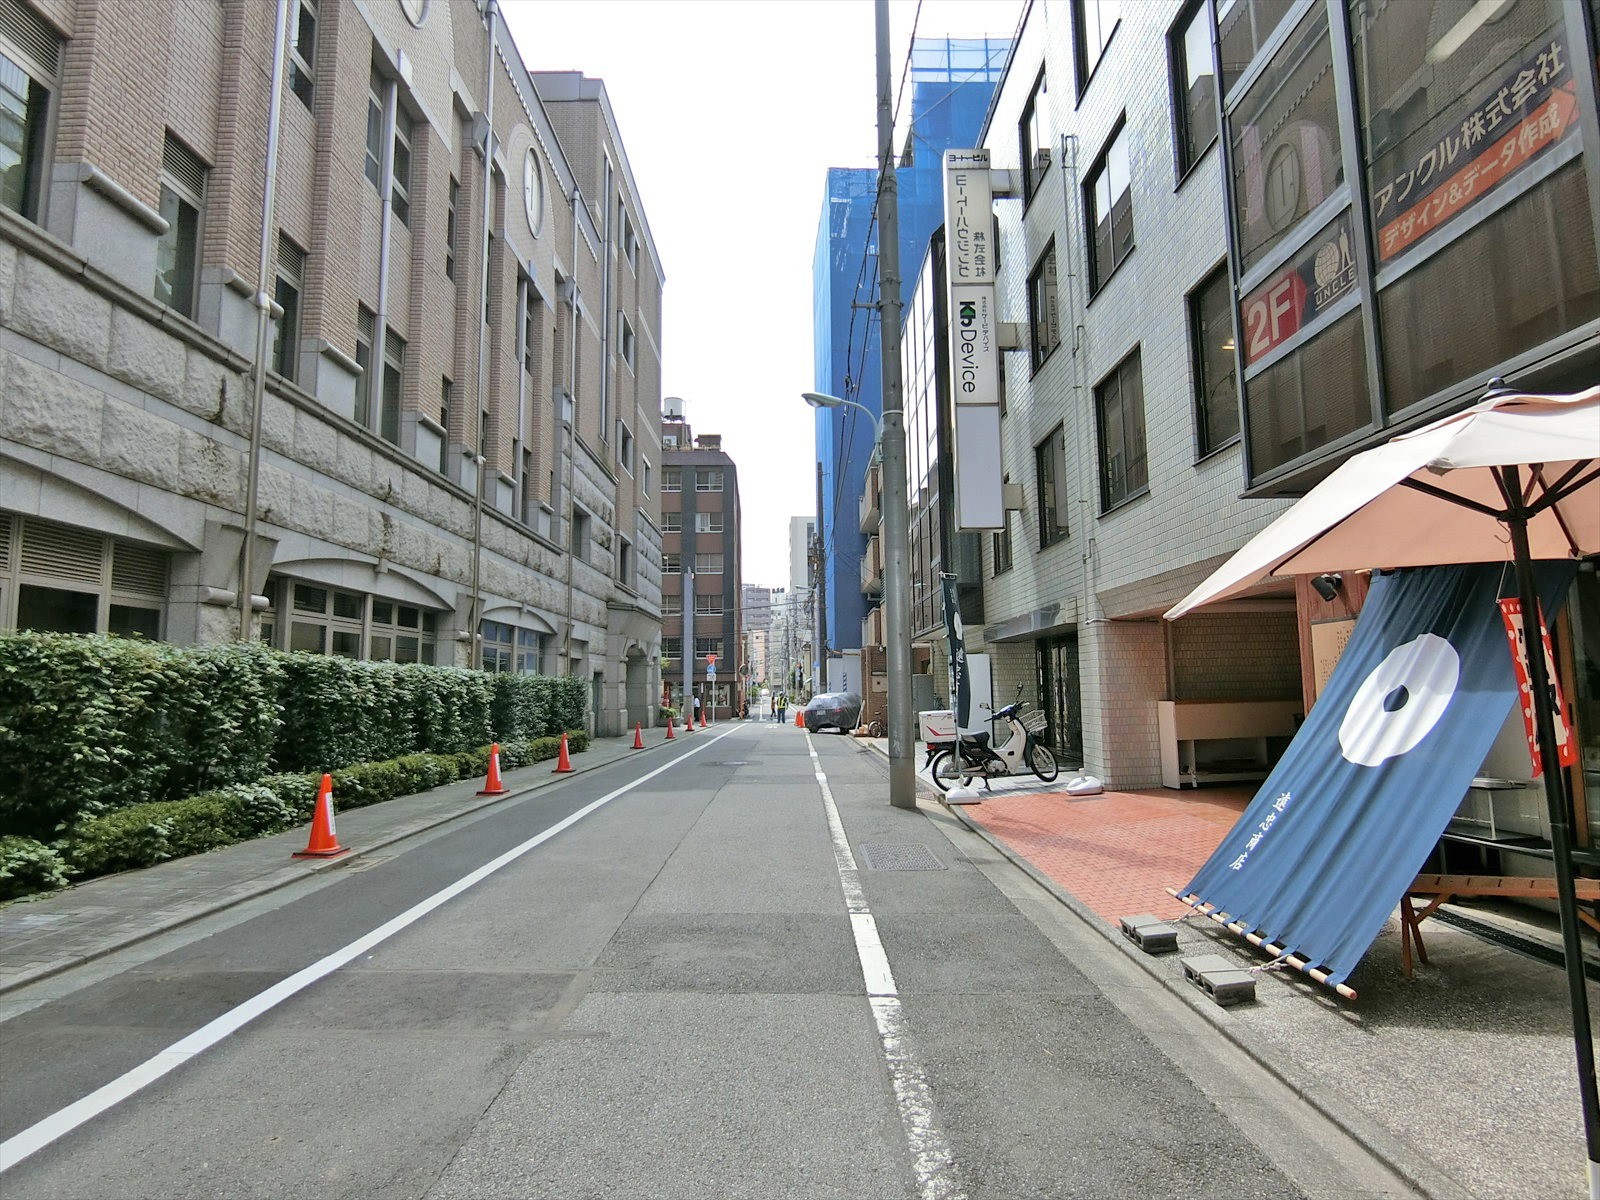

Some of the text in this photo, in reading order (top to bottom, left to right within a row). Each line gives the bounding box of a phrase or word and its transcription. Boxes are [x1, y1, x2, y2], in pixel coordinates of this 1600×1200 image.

[948, 154, 989, 162] ヨートービル
[1374, 40, 1566, 219] アンクル株式会社
[1384, 102, 1561, 252] デザイン&データ作成
[1247, 278, 1292, 358] 2F
[1315, 270, 1356, 307] UNCLE
[960, 329, 979, 393] Device
